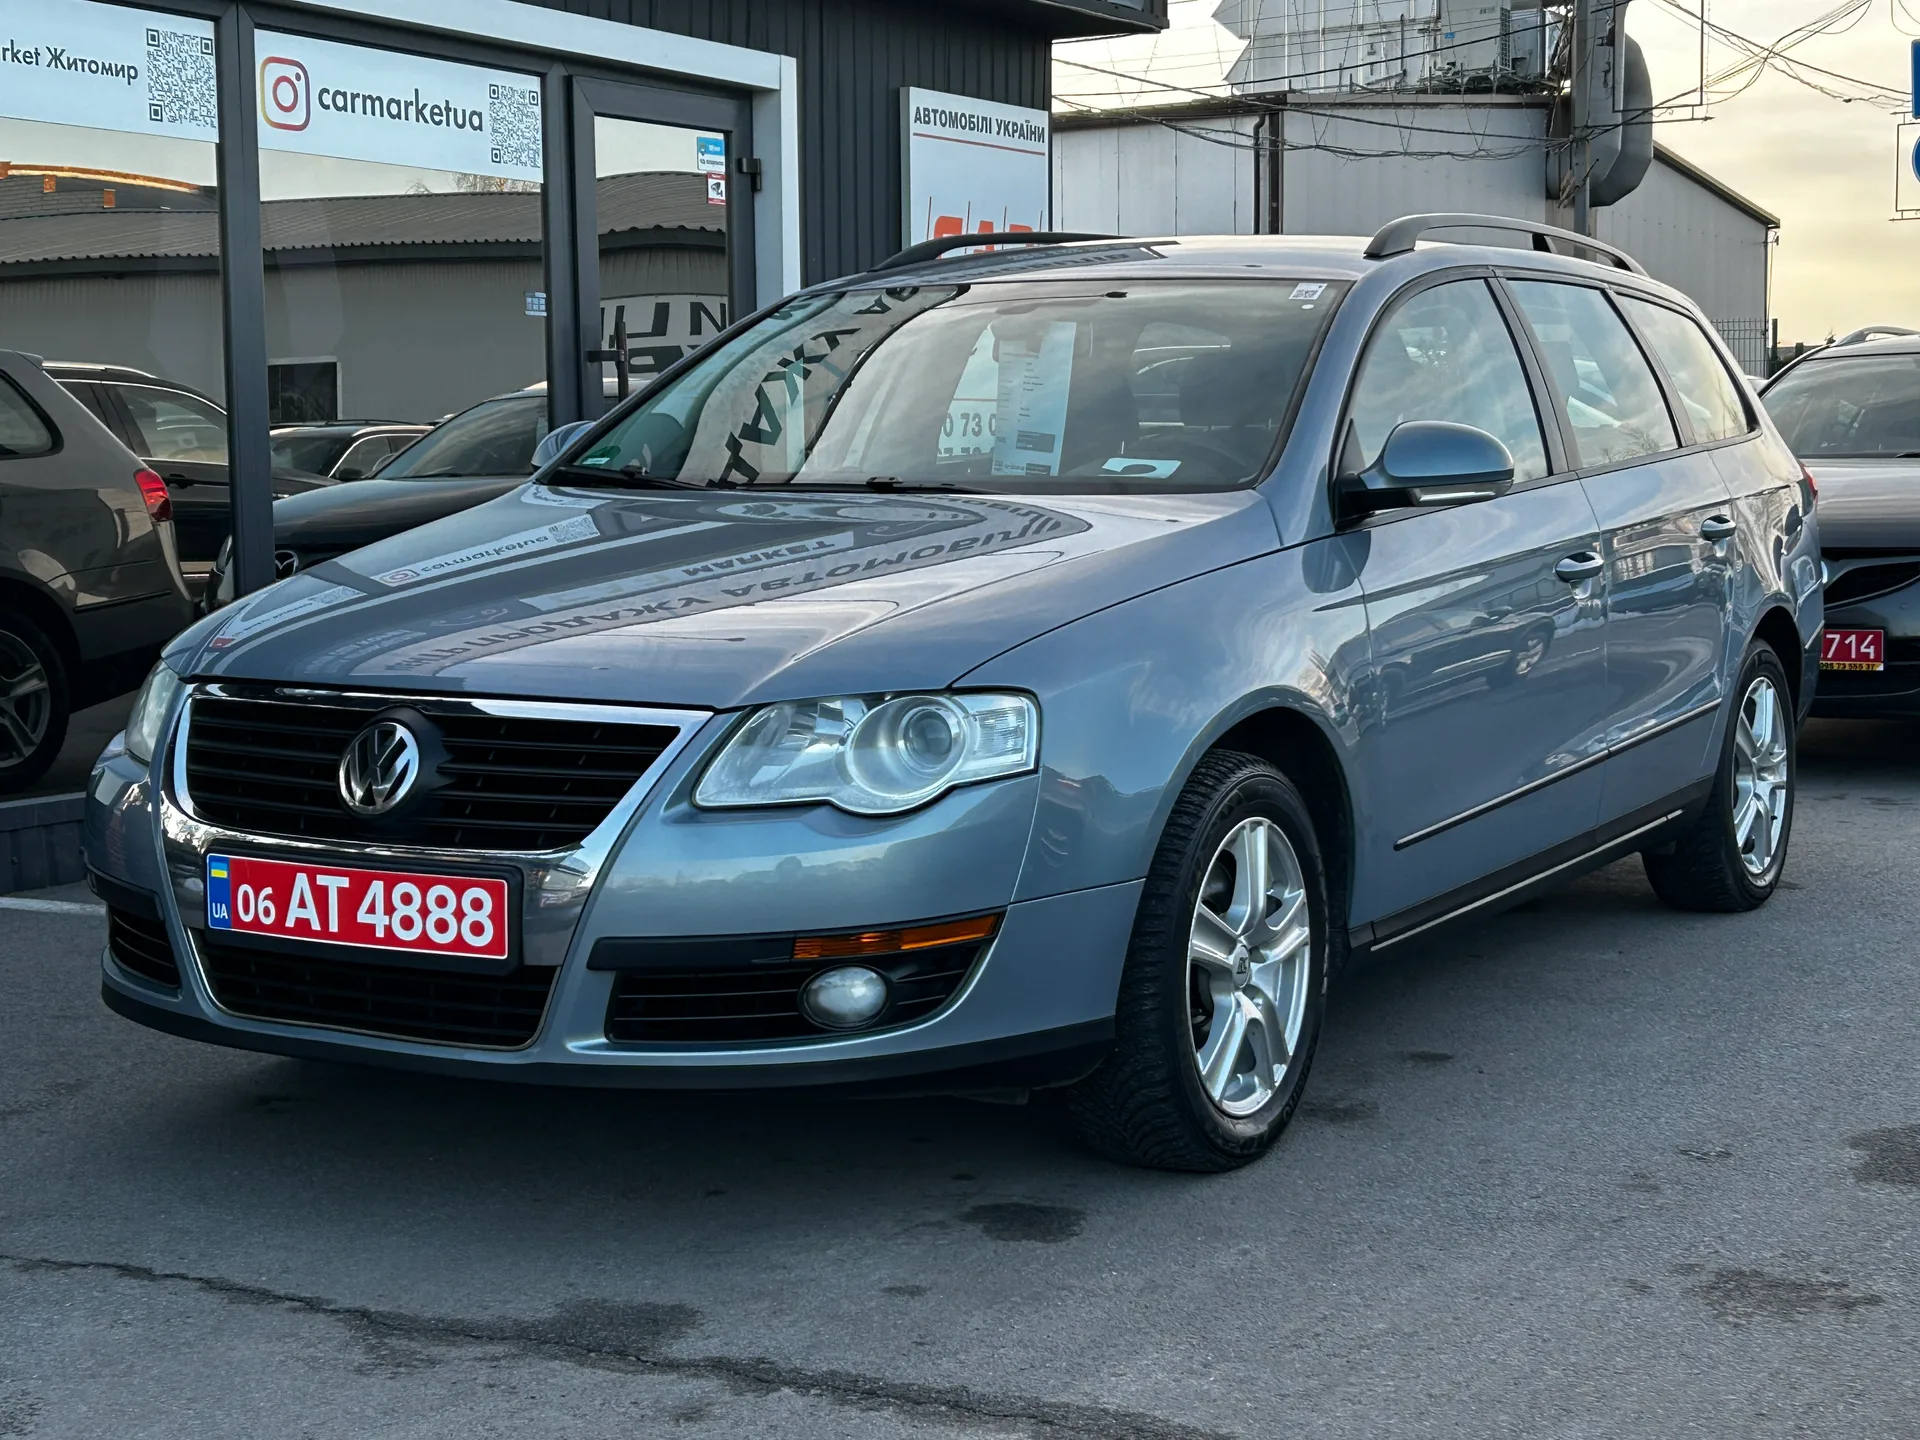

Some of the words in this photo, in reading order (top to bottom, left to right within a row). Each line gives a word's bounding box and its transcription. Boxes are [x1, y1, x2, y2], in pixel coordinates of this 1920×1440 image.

[2, 39, 40, 66] rket
[45, 46, 138, 86] Житомир
[318, 87, 483, 131] carmarketua
[913, 106, 992, 134] АВТОМОБІЛІ
[995, 118, 1045, 143] УКРАЇНИ
[960, 413, 982, 437] 73
[212, 902, 229, 920] UA
[237, 884, 276, 925] 06
[285, 872, 349, 933] AT
[357, 880, 494, 947] 4888
